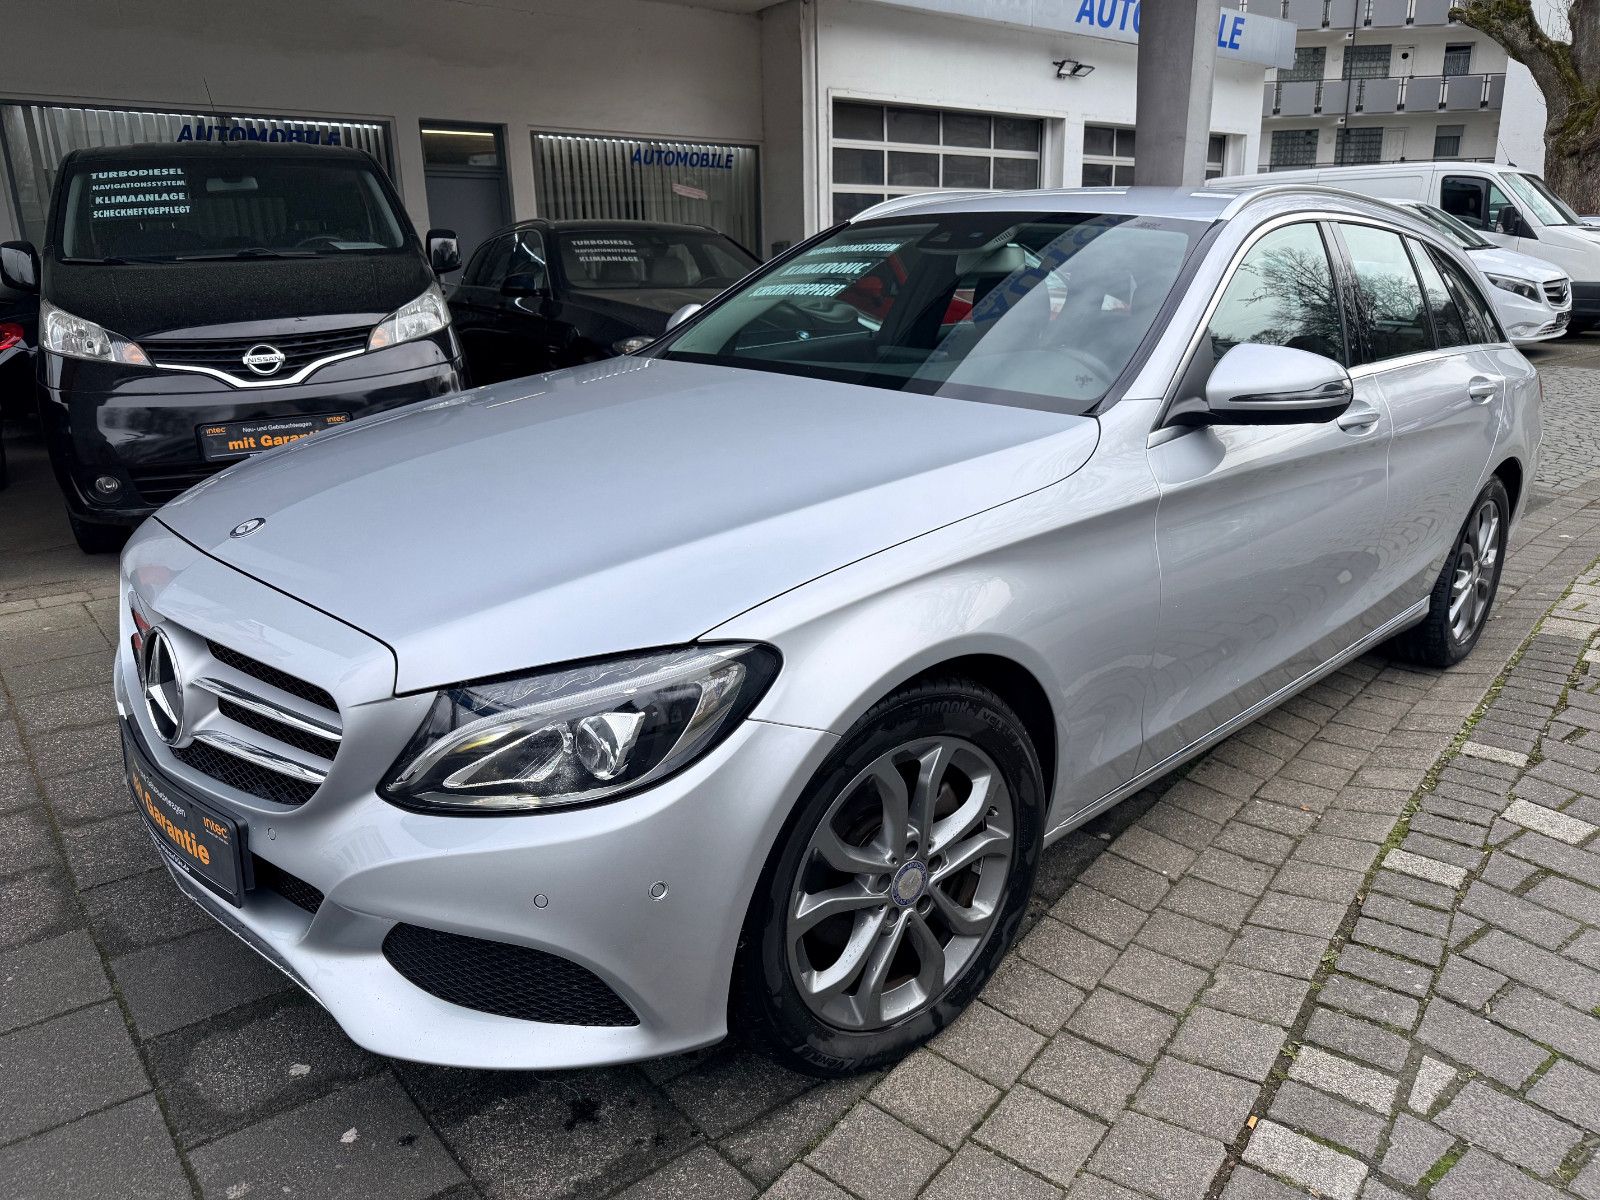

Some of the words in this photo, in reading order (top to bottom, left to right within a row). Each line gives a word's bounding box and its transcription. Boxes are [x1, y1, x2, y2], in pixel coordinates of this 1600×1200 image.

[631, 148, 735, 169] AUTOMOBILE
[90, 168, 185, 180] TURBODIESEL
[92, 180, 186, 191] NAVIGATIONSSYSTEM
[95, 193, 186, 205] KLIMAANLAGE
[93, 205, 191, 219] SCHECKHEFTGEPFLEGT
[247, 355, 281, 363] NISSAN
[326, 415, 346, 423] intec
[206, 426, 227, 435] intec
[228, 436, 257, 450] mit
[145, 791, 210, 865] Garantie
[203, 816, 228, 839] intec
